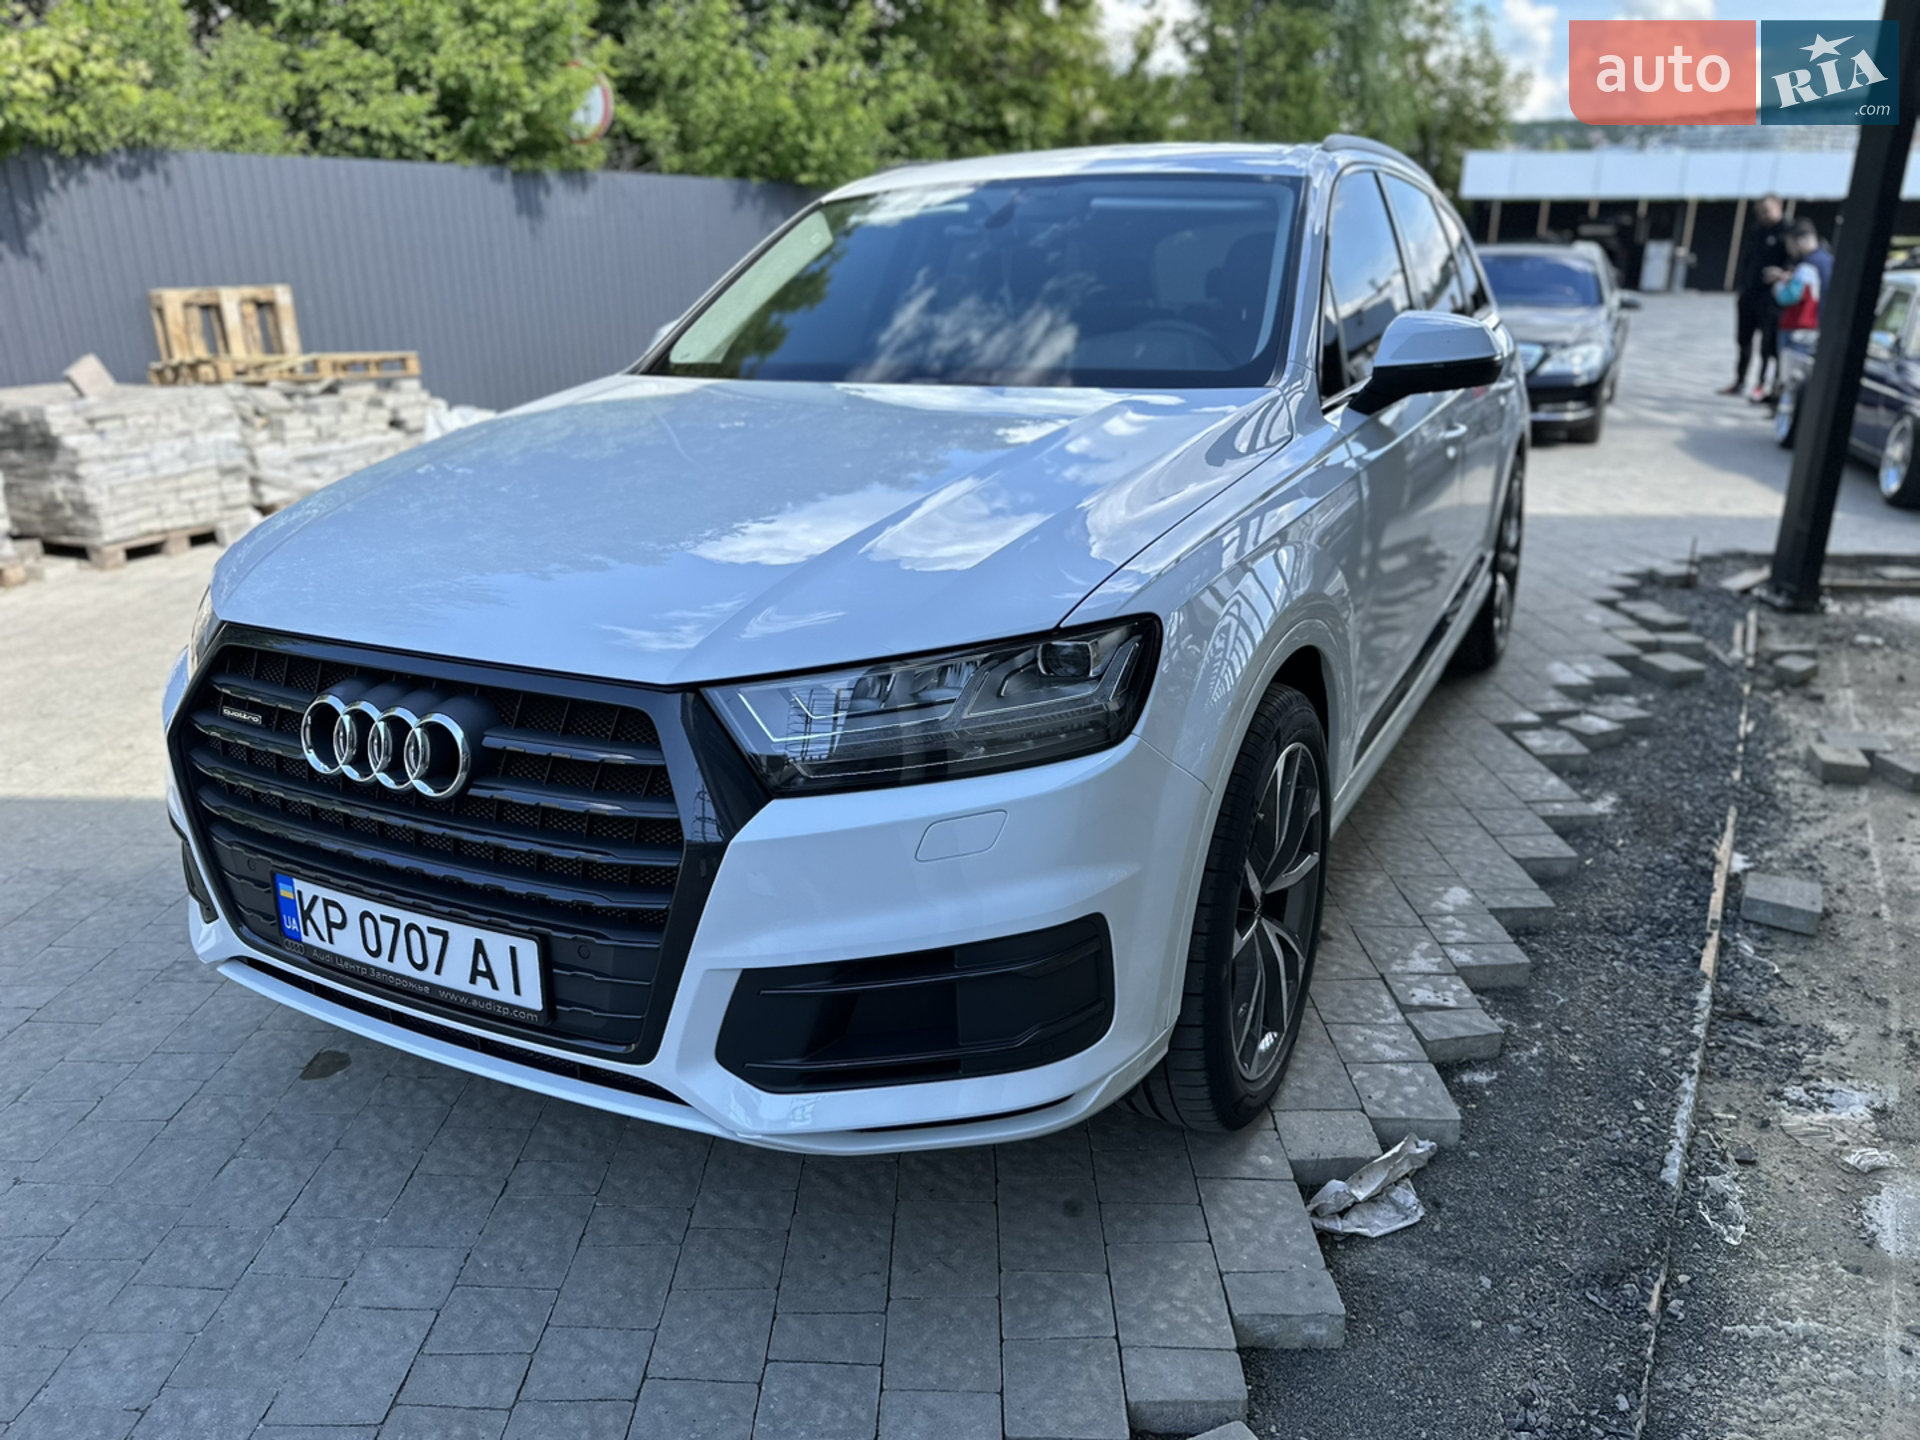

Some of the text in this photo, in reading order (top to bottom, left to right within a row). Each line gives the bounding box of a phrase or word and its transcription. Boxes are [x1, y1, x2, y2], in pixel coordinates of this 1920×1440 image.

[283, 914, 300, 933] UA
[296, 889, 522, 997] KP 0707 AI
[312, 948, 539, 1022] Audi Центр Запорожье www.audizp.com
